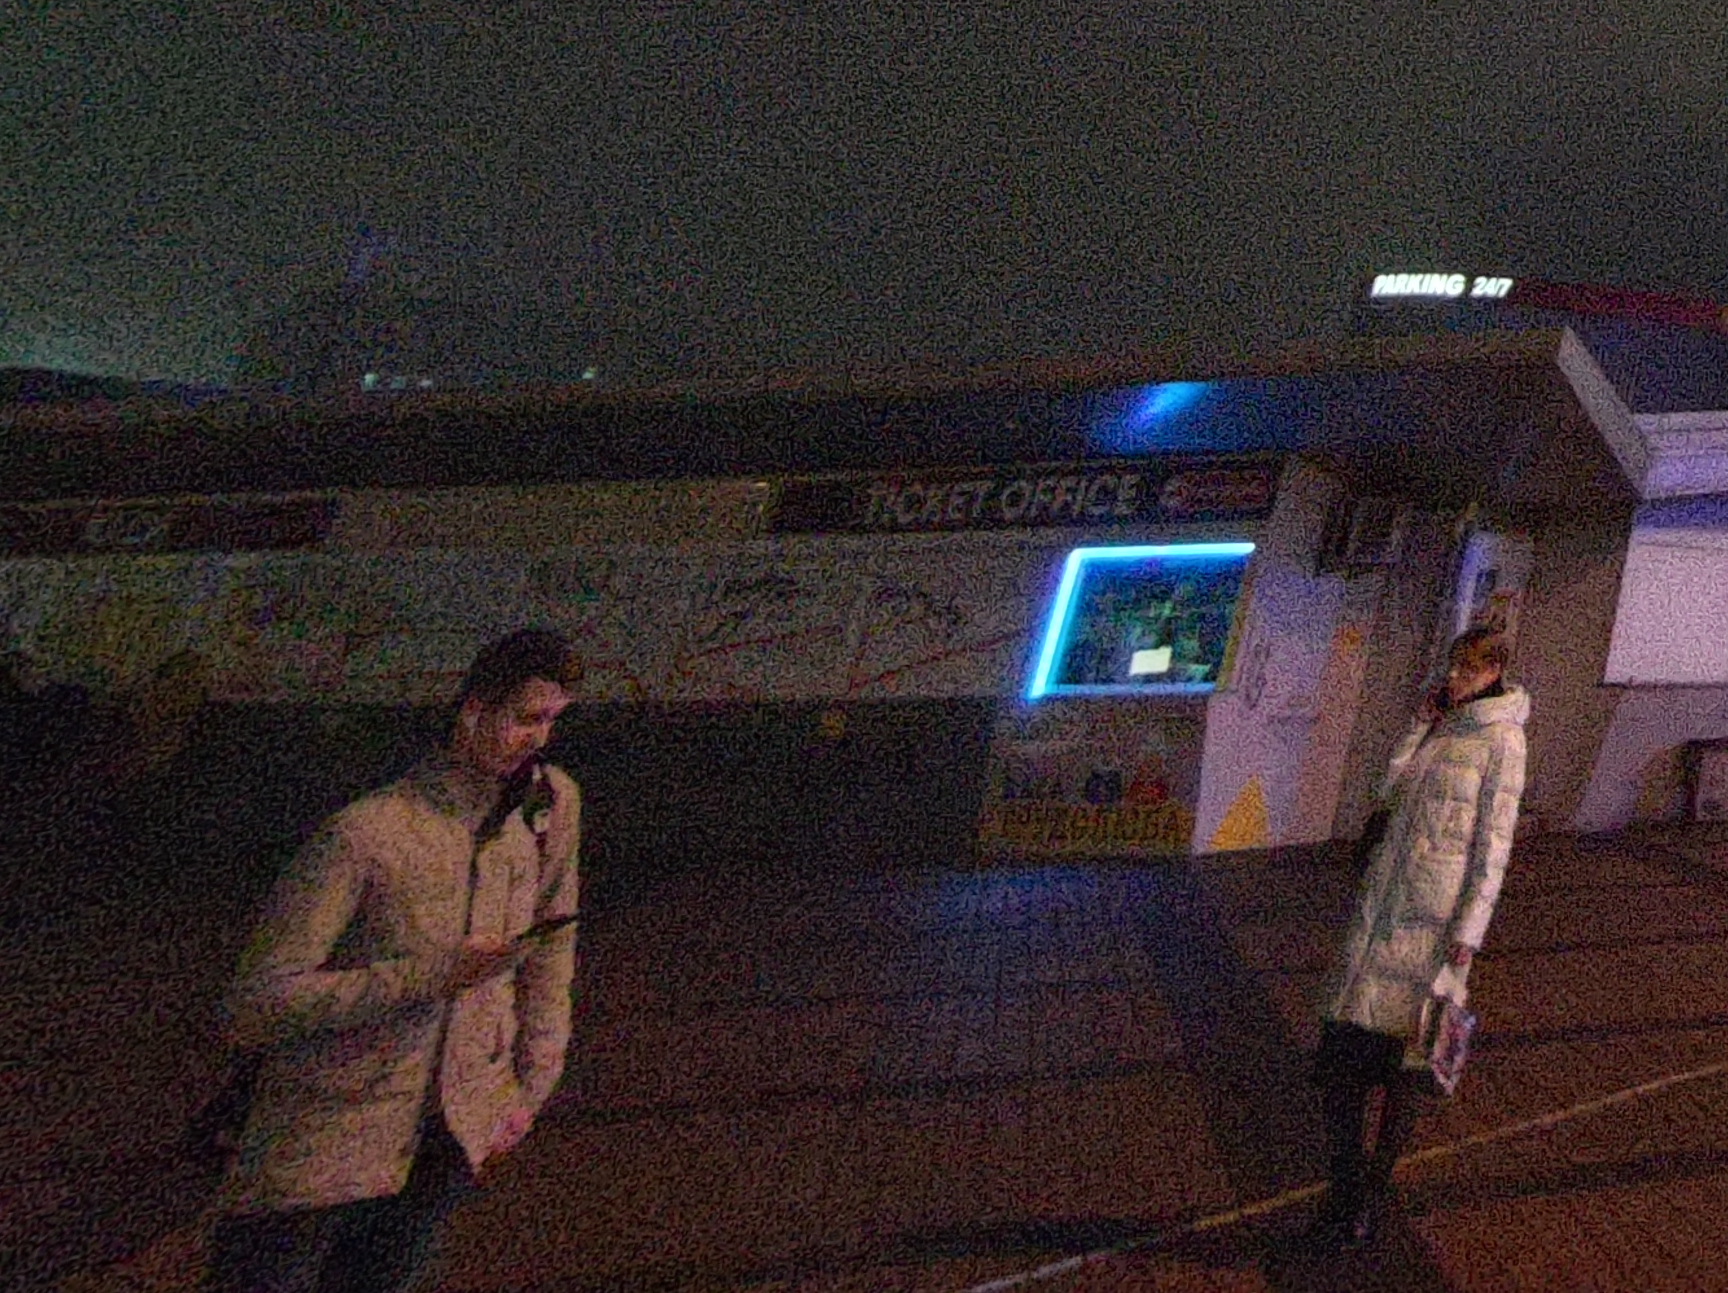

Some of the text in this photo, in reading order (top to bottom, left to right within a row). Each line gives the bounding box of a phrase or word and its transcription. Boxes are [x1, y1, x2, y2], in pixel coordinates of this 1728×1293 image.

[1371, 273, 1514, 298] PARKING 24/7
[863, 480, 995, 524] TICKET
[999, 474, 1141, 519] OFFICE
